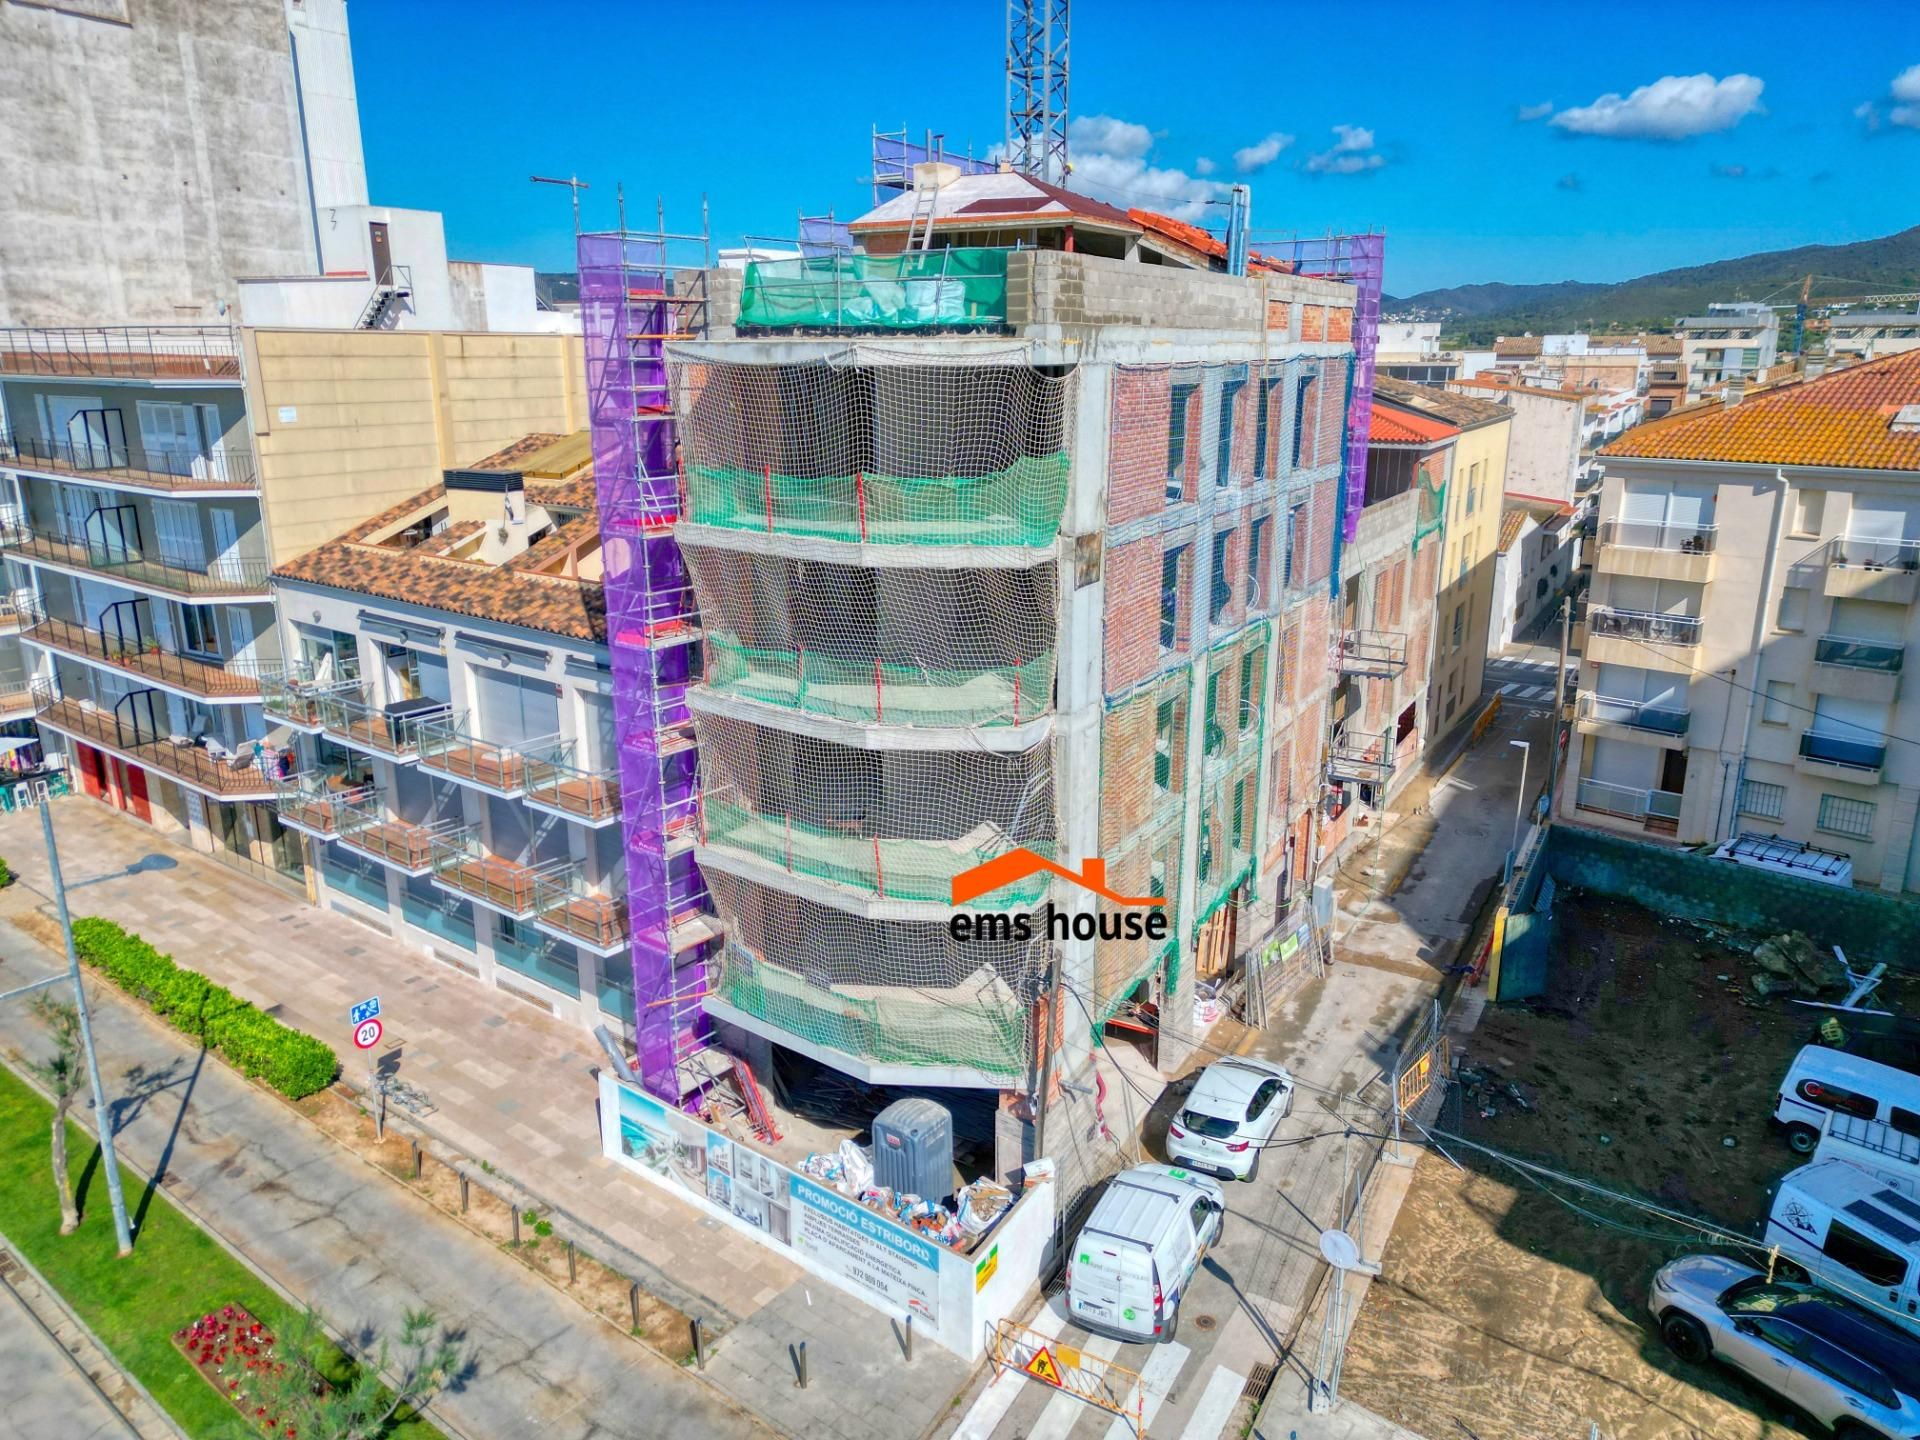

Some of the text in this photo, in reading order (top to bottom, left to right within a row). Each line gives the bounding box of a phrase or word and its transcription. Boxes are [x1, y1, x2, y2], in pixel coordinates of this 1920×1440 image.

[361, 1026, 376, 1042] 20
[798, 1184, 929, 1261] PROMOCIÓ ESTRIBORD
